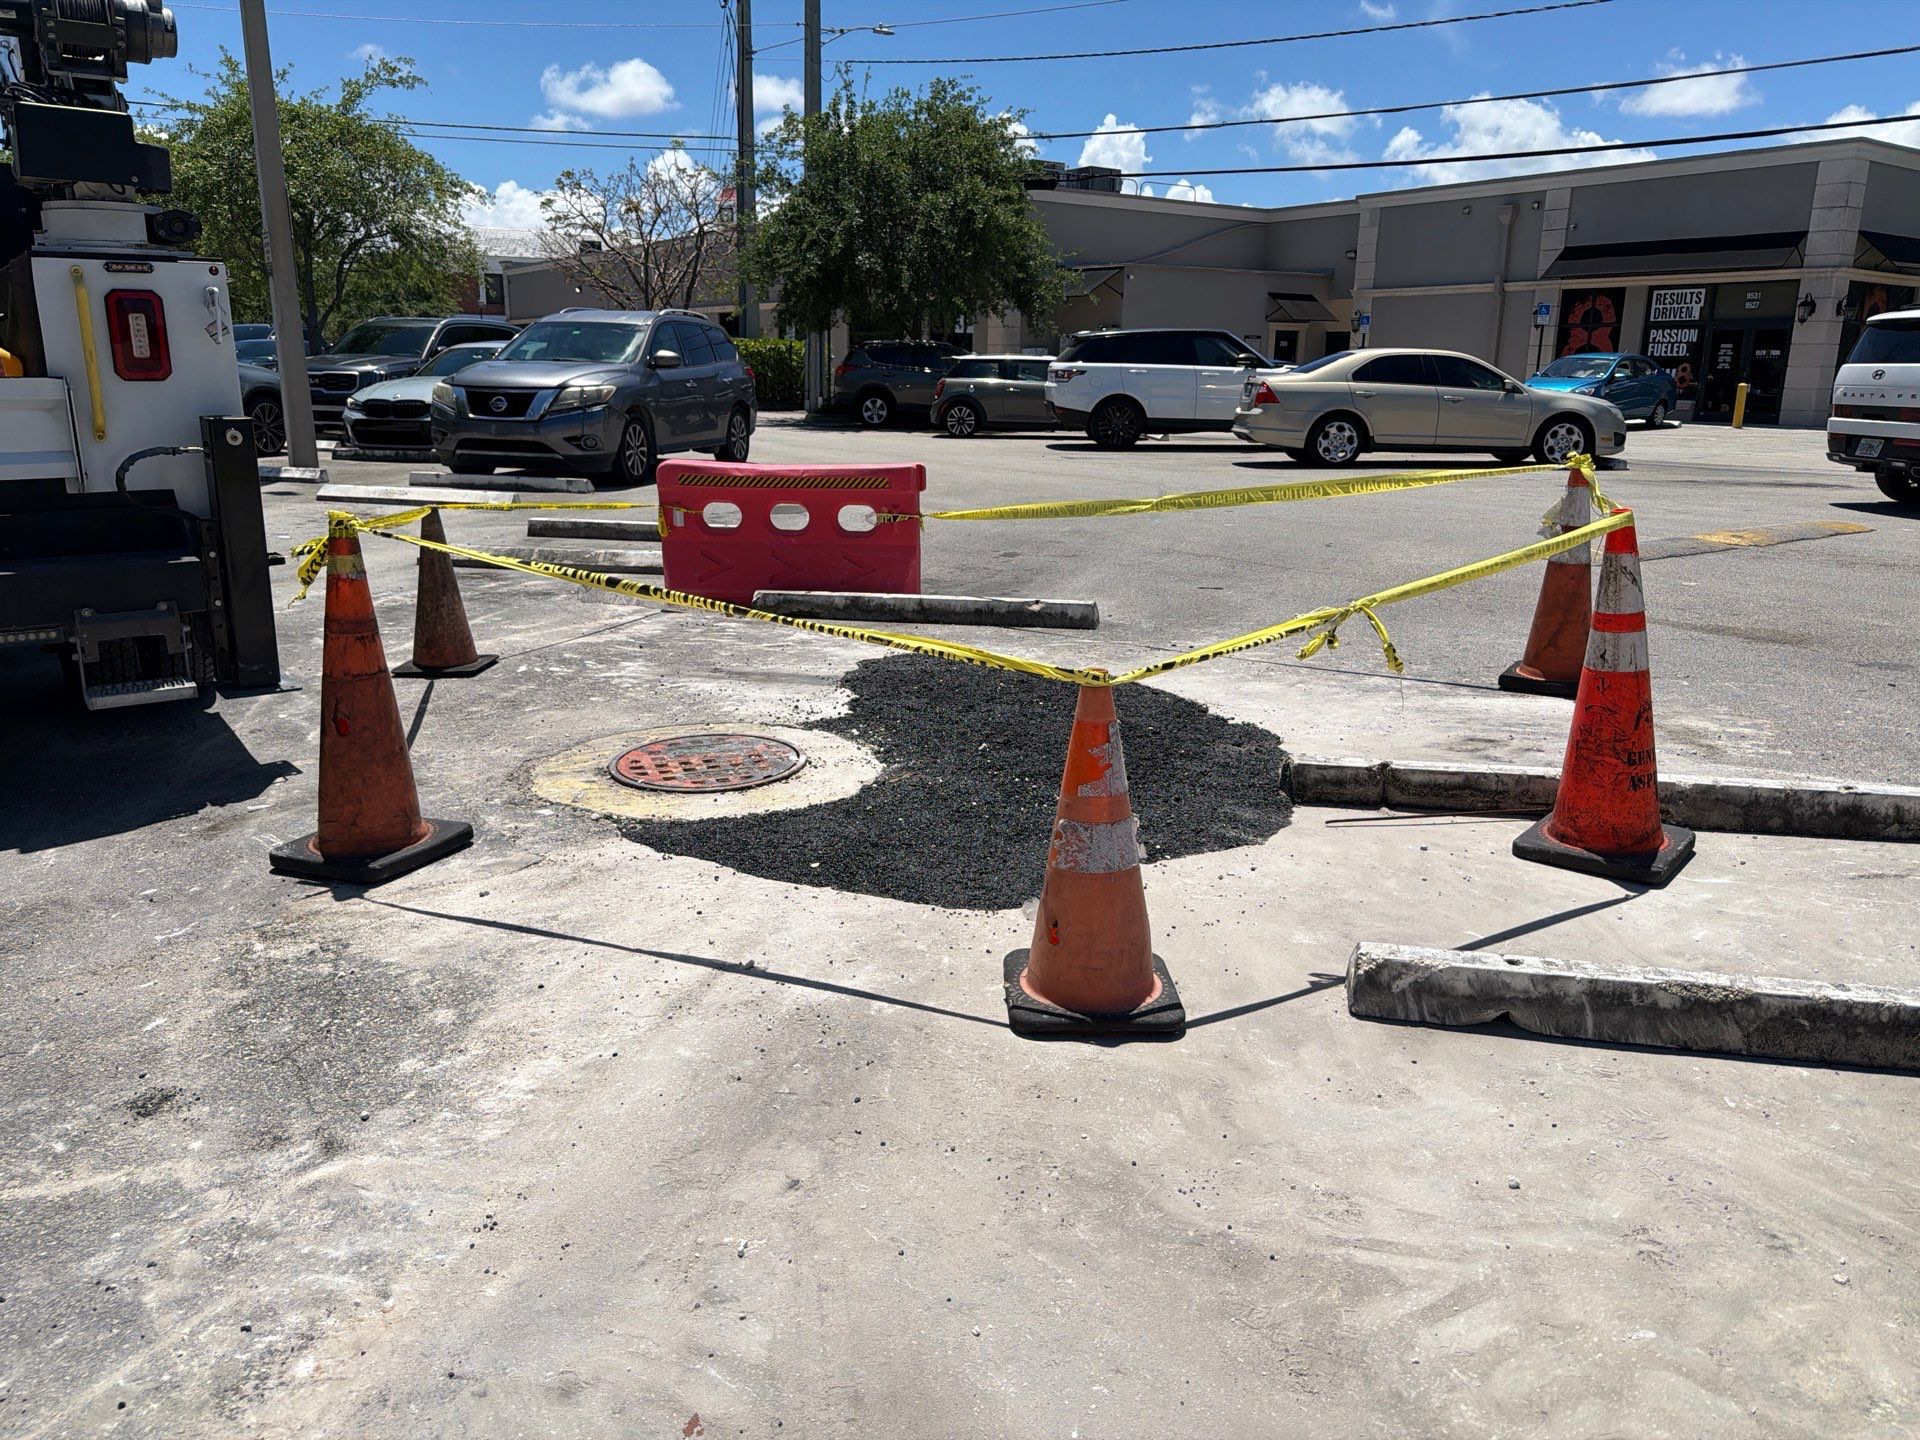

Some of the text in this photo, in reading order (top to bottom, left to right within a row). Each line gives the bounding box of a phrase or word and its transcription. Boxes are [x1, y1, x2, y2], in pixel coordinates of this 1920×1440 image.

[1655, 290, 1703, 306] RESULTS
[1746, 292, 1762, 300] 9531
[1653, 305, 1696, 320] DRIVEN.
[1649, 328, 1699, 343] PASSION
[1647, 342, 1690, 357] FUELED.
